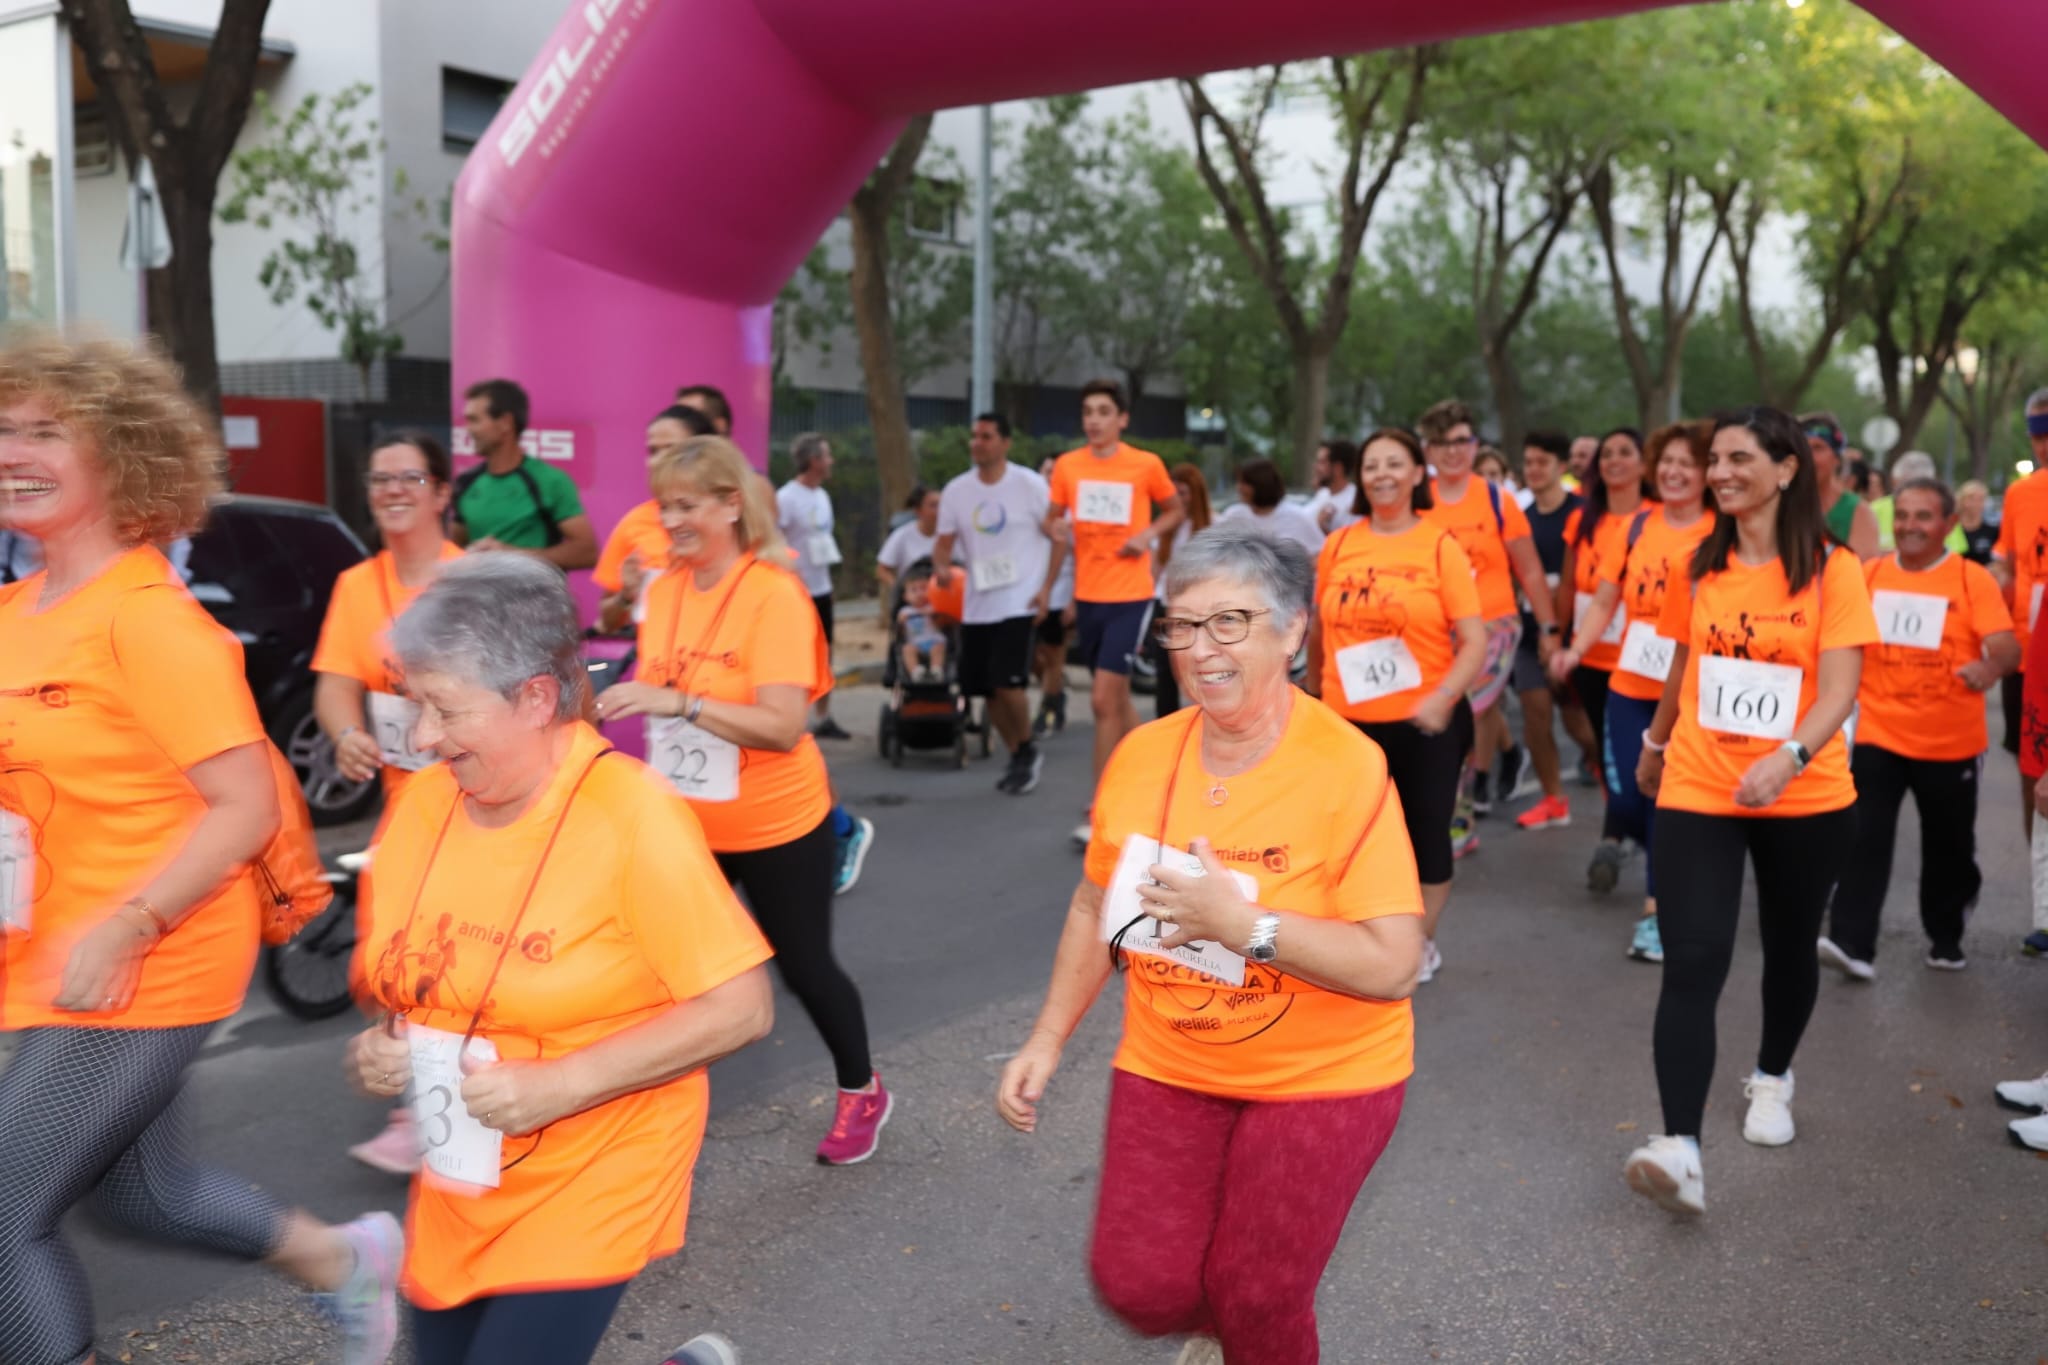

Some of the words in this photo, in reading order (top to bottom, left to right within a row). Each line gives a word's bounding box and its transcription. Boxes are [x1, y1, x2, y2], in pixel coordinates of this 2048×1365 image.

[1892, 611, 1922, 637] 10
[1363, 658, 1397, 686] 49
[1715, 684, 1780, 725] 160
[666, 744, 709, 784] 22
[1211, 845, 1260, 863] miab
[427, 1083, 453, 1148] 3
